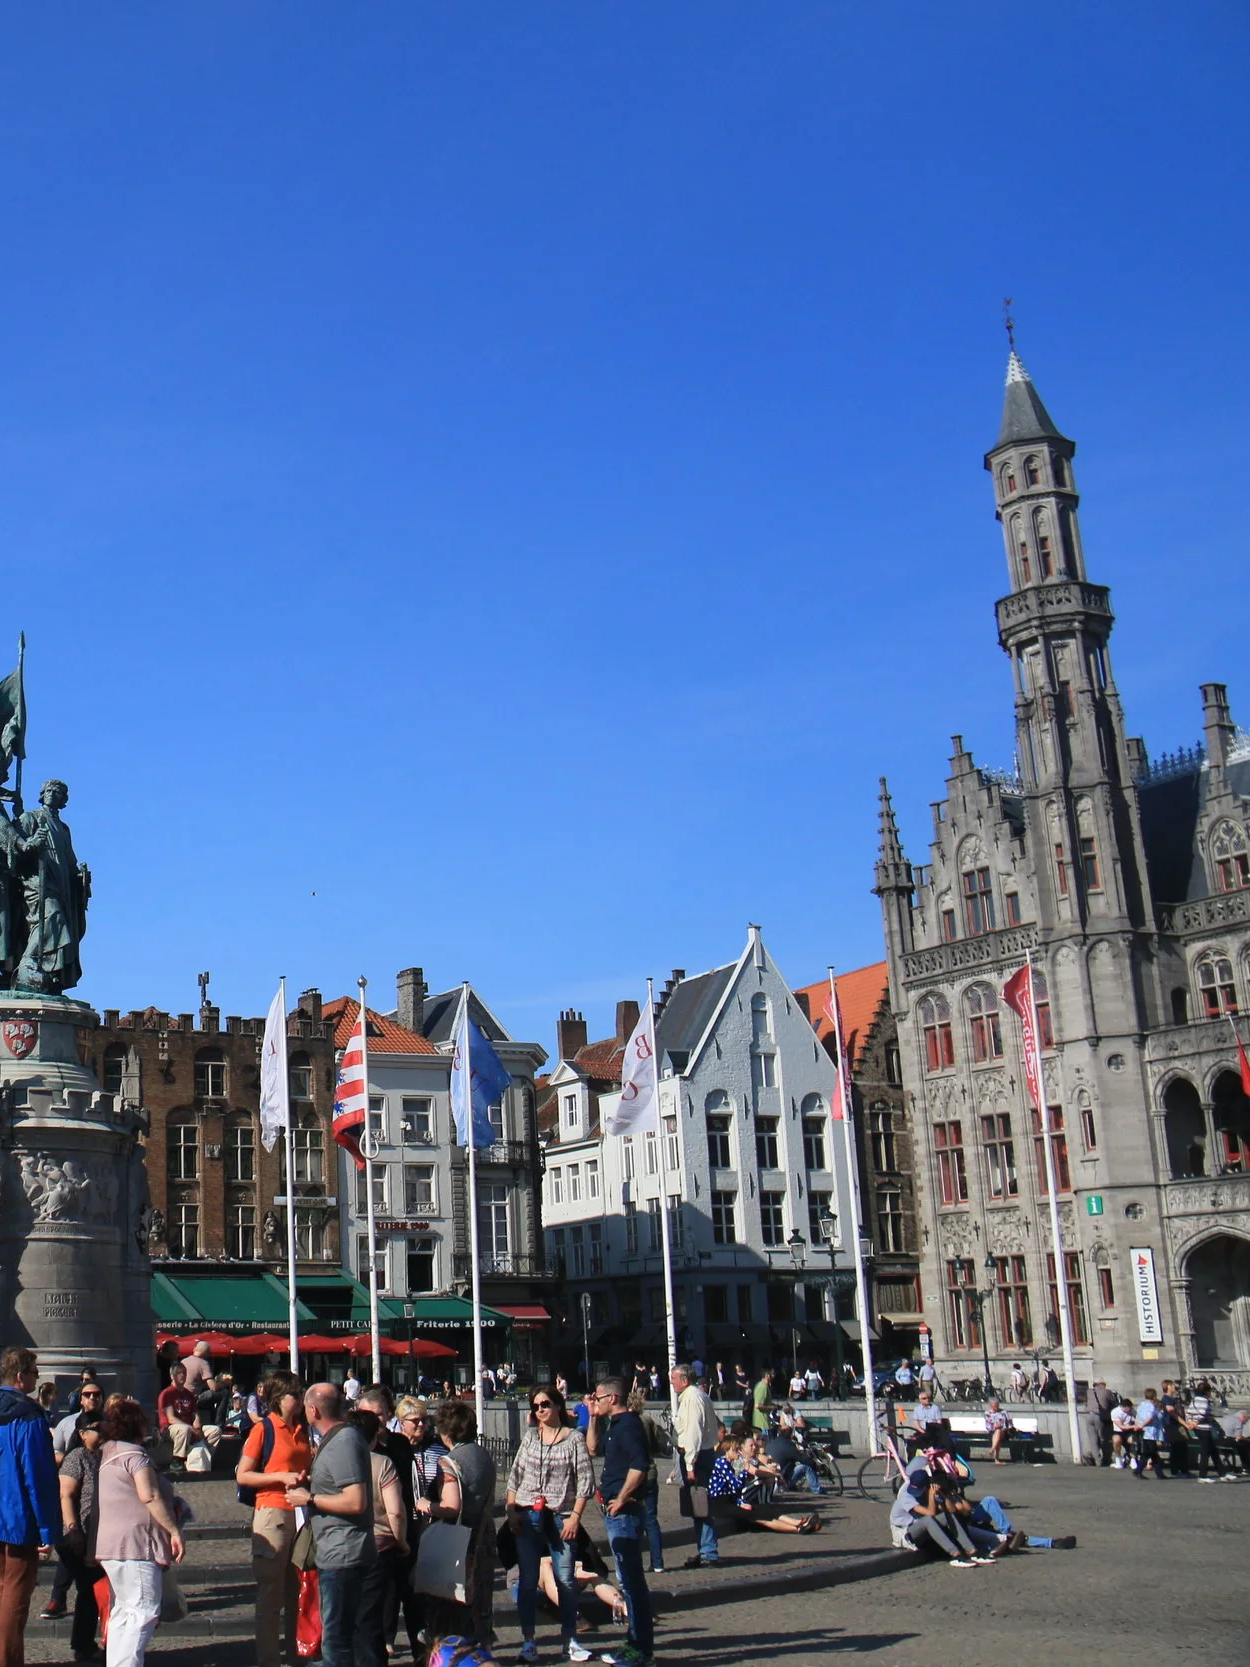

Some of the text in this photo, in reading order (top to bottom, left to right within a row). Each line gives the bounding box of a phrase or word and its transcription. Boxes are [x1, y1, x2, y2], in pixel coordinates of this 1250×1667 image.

[375, 1222, 408, 1231] RITERIE
[1138, 1266, 1155, 1334] HISTORIUM
[154, 1320, 182, 1329] sserie
[251, 1320, 290, 1330] Restaurant
[330, 1320, 355, 1329] PETIT
[416, 1320, 461, 1329] Friterie
